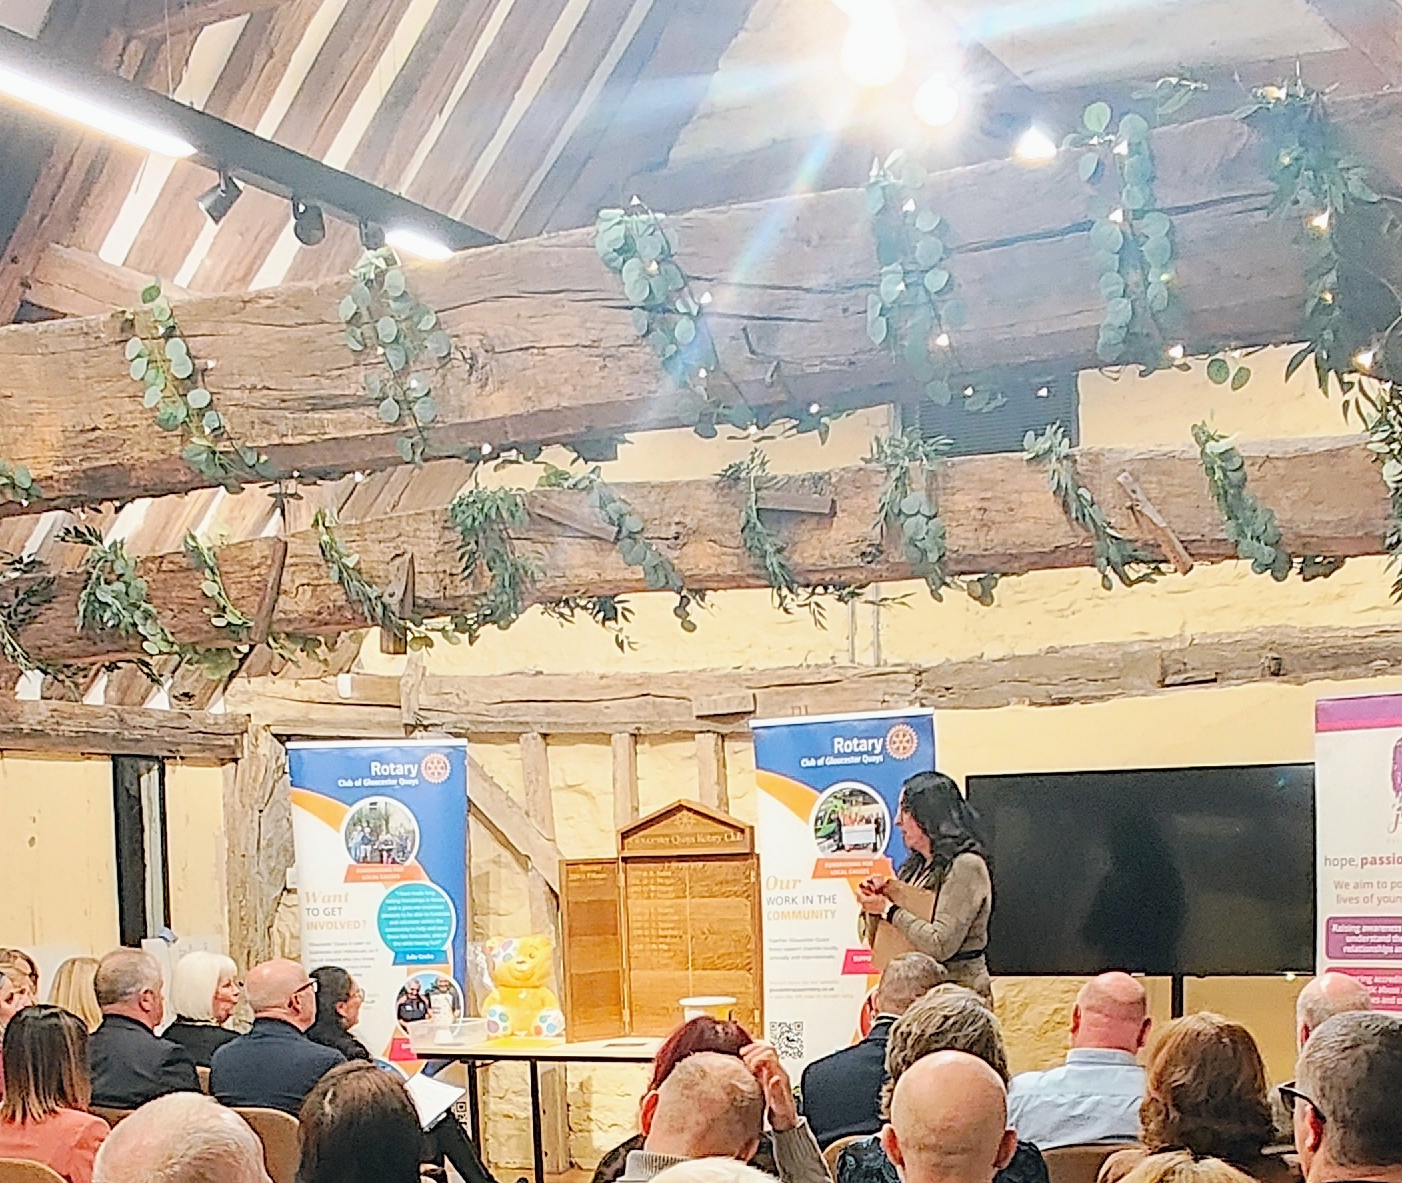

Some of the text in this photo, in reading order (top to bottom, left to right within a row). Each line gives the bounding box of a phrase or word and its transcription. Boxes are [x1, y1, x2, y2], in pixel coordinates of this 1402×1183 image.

[833, 737, 884, 754] Rotary
[800, 753, 884, 768] Club of Gloucester Quays
[370, 761, 419, 777] Rotary
[337, 776, 420, 788] Club of Gloucester Quays
[724, 831, 745, 843] Club
[1324, 854, 1359, 870] hope,
[765, 875, 802, 891] Our
[1333, 879, 1350, 890] We
[1353, 879, 1373, 890] aim
[1377, 879, 1387, 889] to
[304, 891, 349, 904] Want
[766, 894, 838, 906] WORK IN THE
[1336, 893, 1360, 905] lives
[1363, 893, 1373, 904] of
[306, 906, 343, 917] TO GET
[766, 909, 837, 921] COMMUNITY
[306, 920, 367, 931] INVOLVED?
[1332, 923, 1361, 934] Raising
[1362, 924, 1402, 933] awareness
